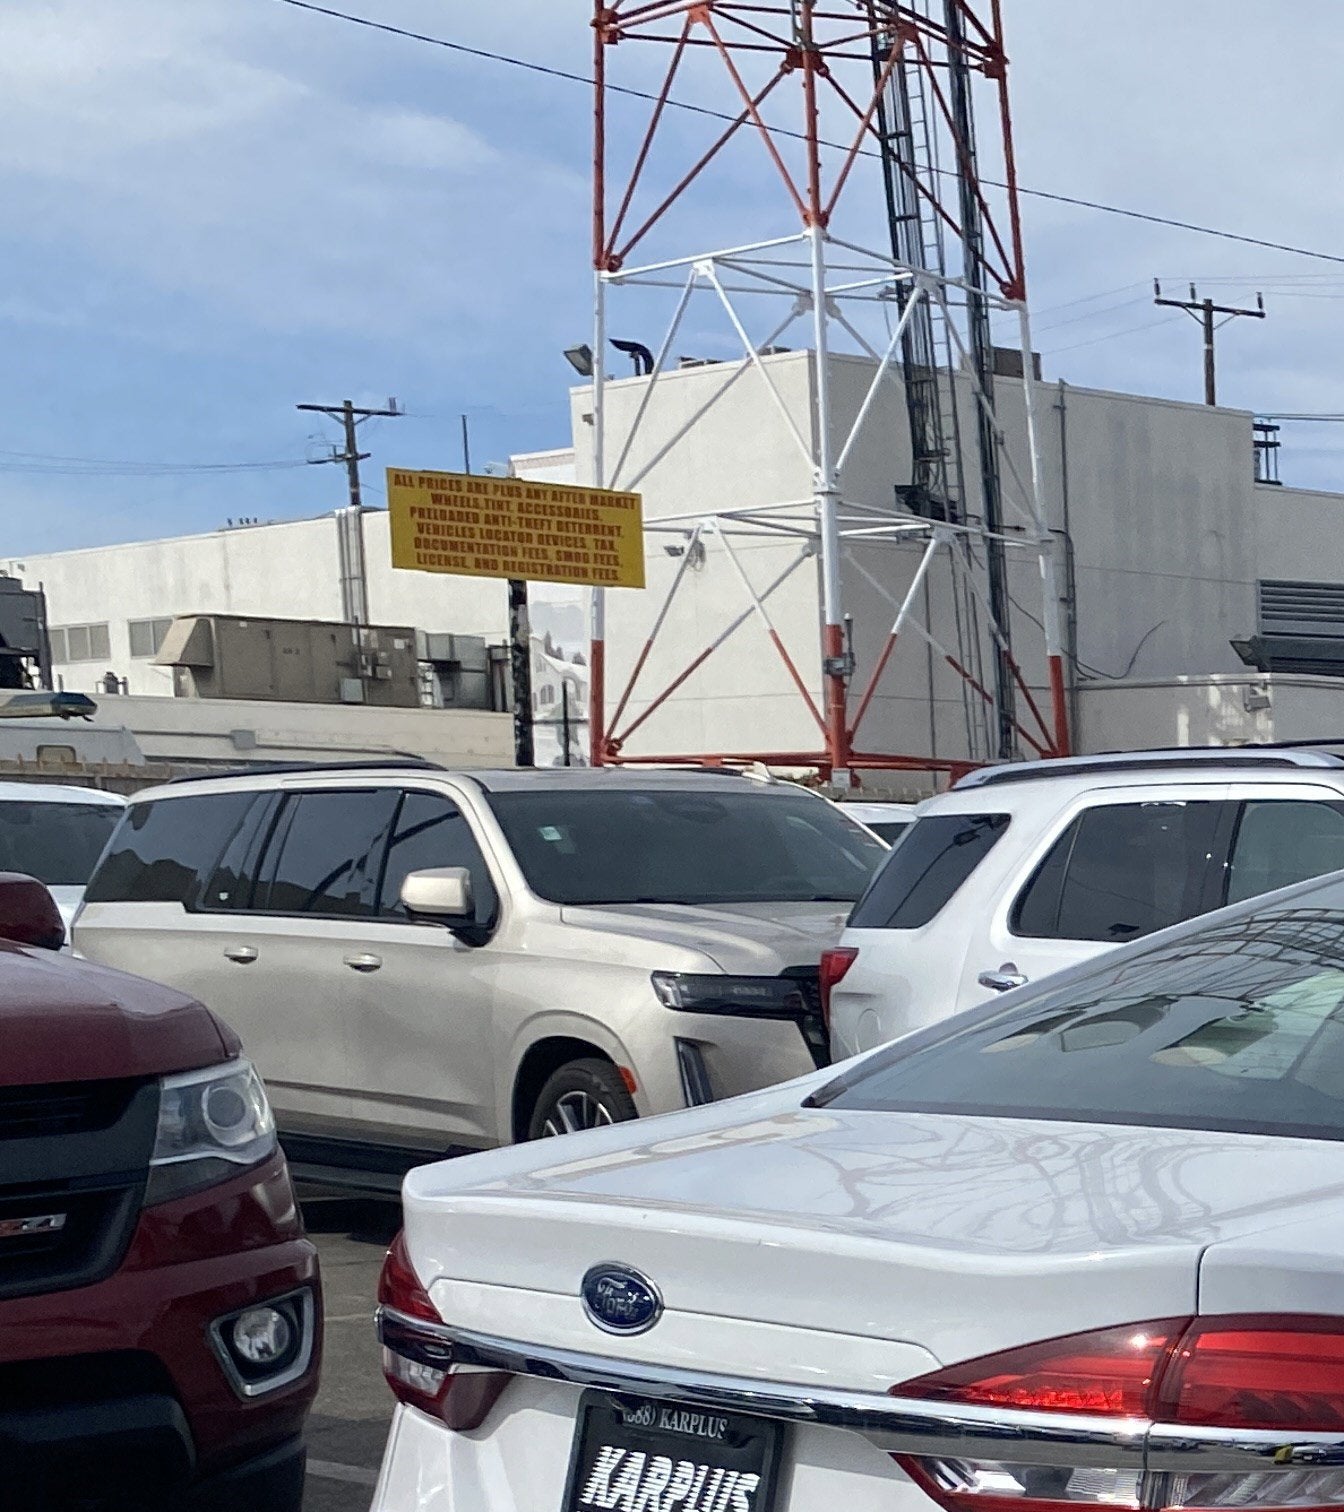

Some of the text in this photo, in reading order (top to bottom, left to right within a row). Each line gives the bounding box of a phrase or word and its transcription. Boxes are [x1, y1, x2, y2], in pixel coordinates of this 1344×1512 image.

[393, 473, 636, 509] ALL PRICES ARE PLUS ANY AFTER MARKET
[417, 522, 475, 538] VEHICLES
[479, 528, 533, 543] LOCATOR
[414, 537, 518, 557] DOCUMENTATION
[474, 557, 499, 570] AND
[503, 560, 588, 577] REGISTRATION
[658, 1408, 728, 1440] KARPLUS
